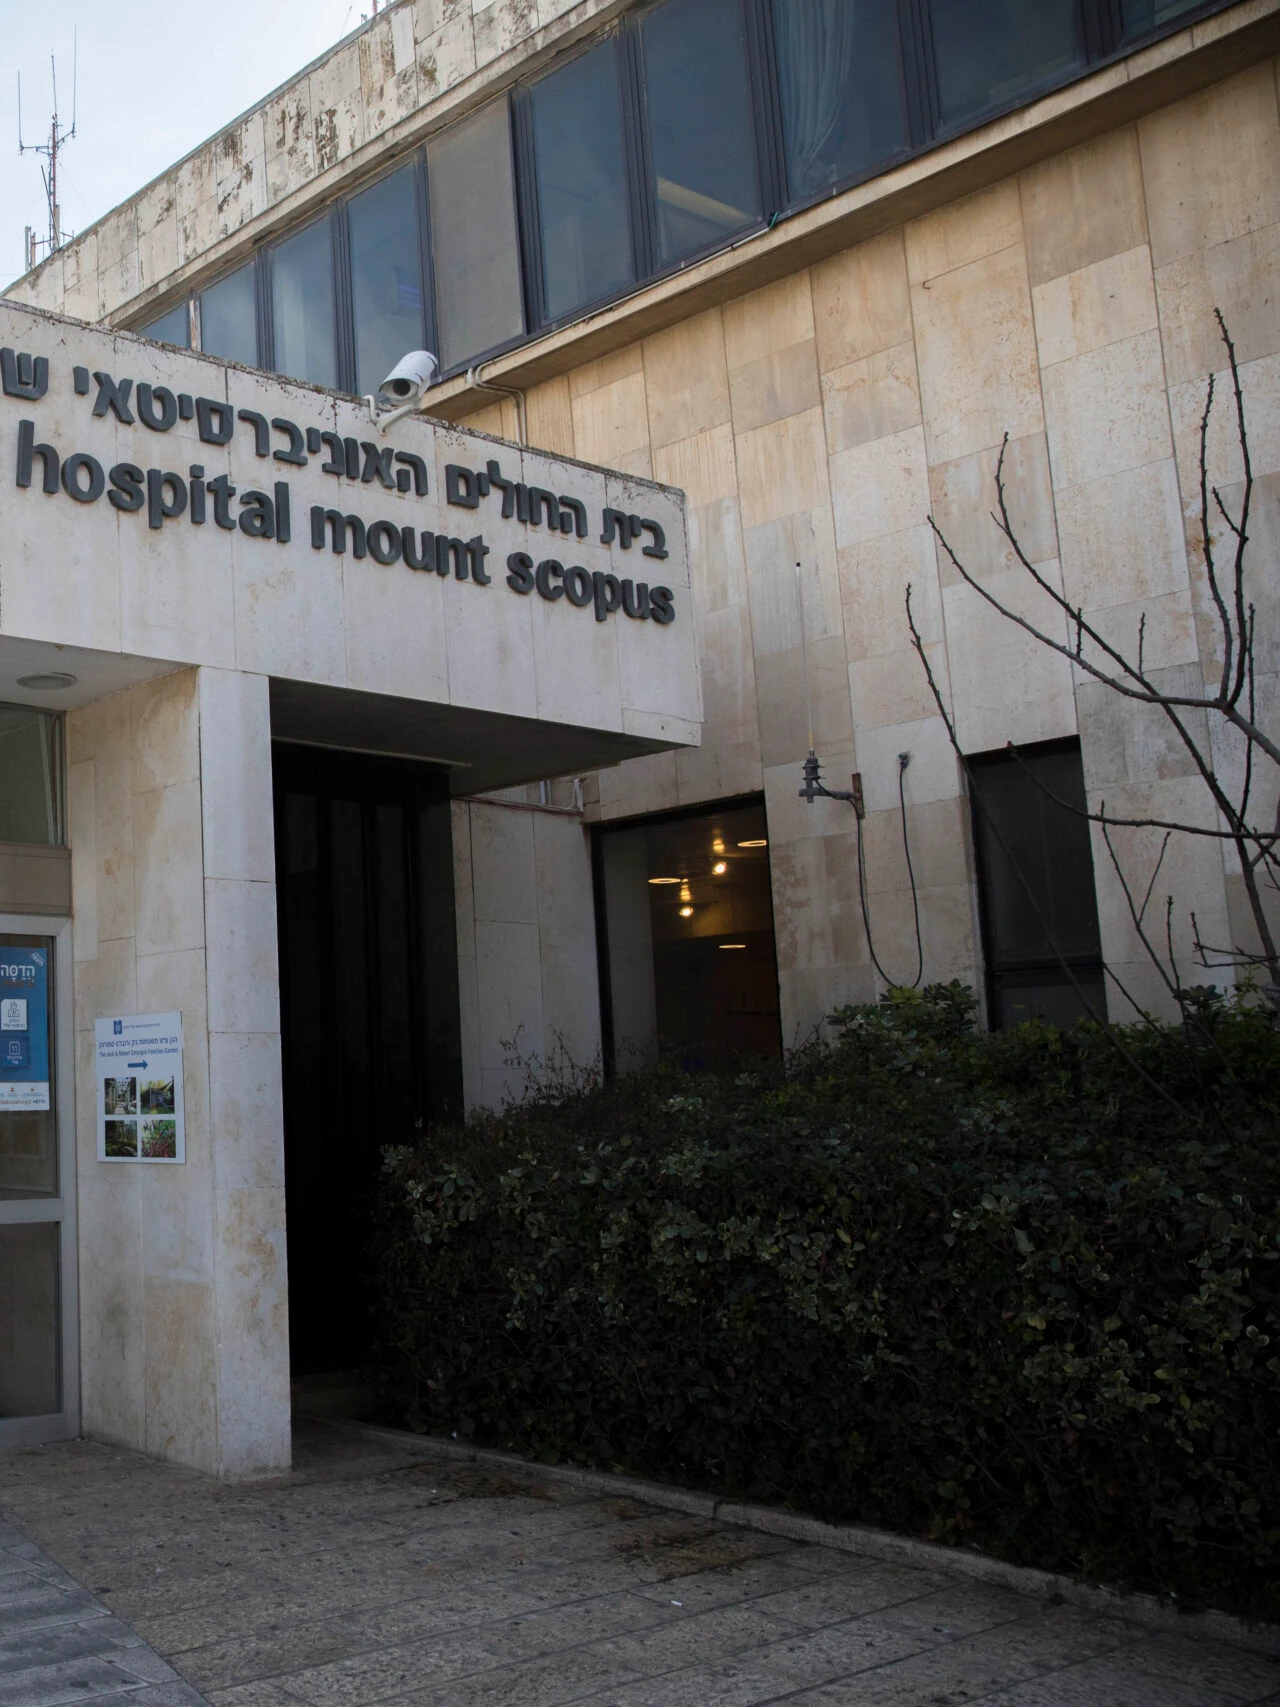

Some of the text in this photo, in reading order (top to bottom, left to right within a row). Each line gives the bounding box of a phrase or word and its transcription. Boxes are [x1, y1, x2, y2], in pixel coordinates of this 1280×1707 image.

[73, 366, 429, 498] האוניברסיטאי
[15, 419, 291, 545] hospital
[310, 505, 492, 588] mount
[505, 551, 676, 627] scopus
[445, 459, 589, 540] החולים
[599, 505, 669, 561] בית
